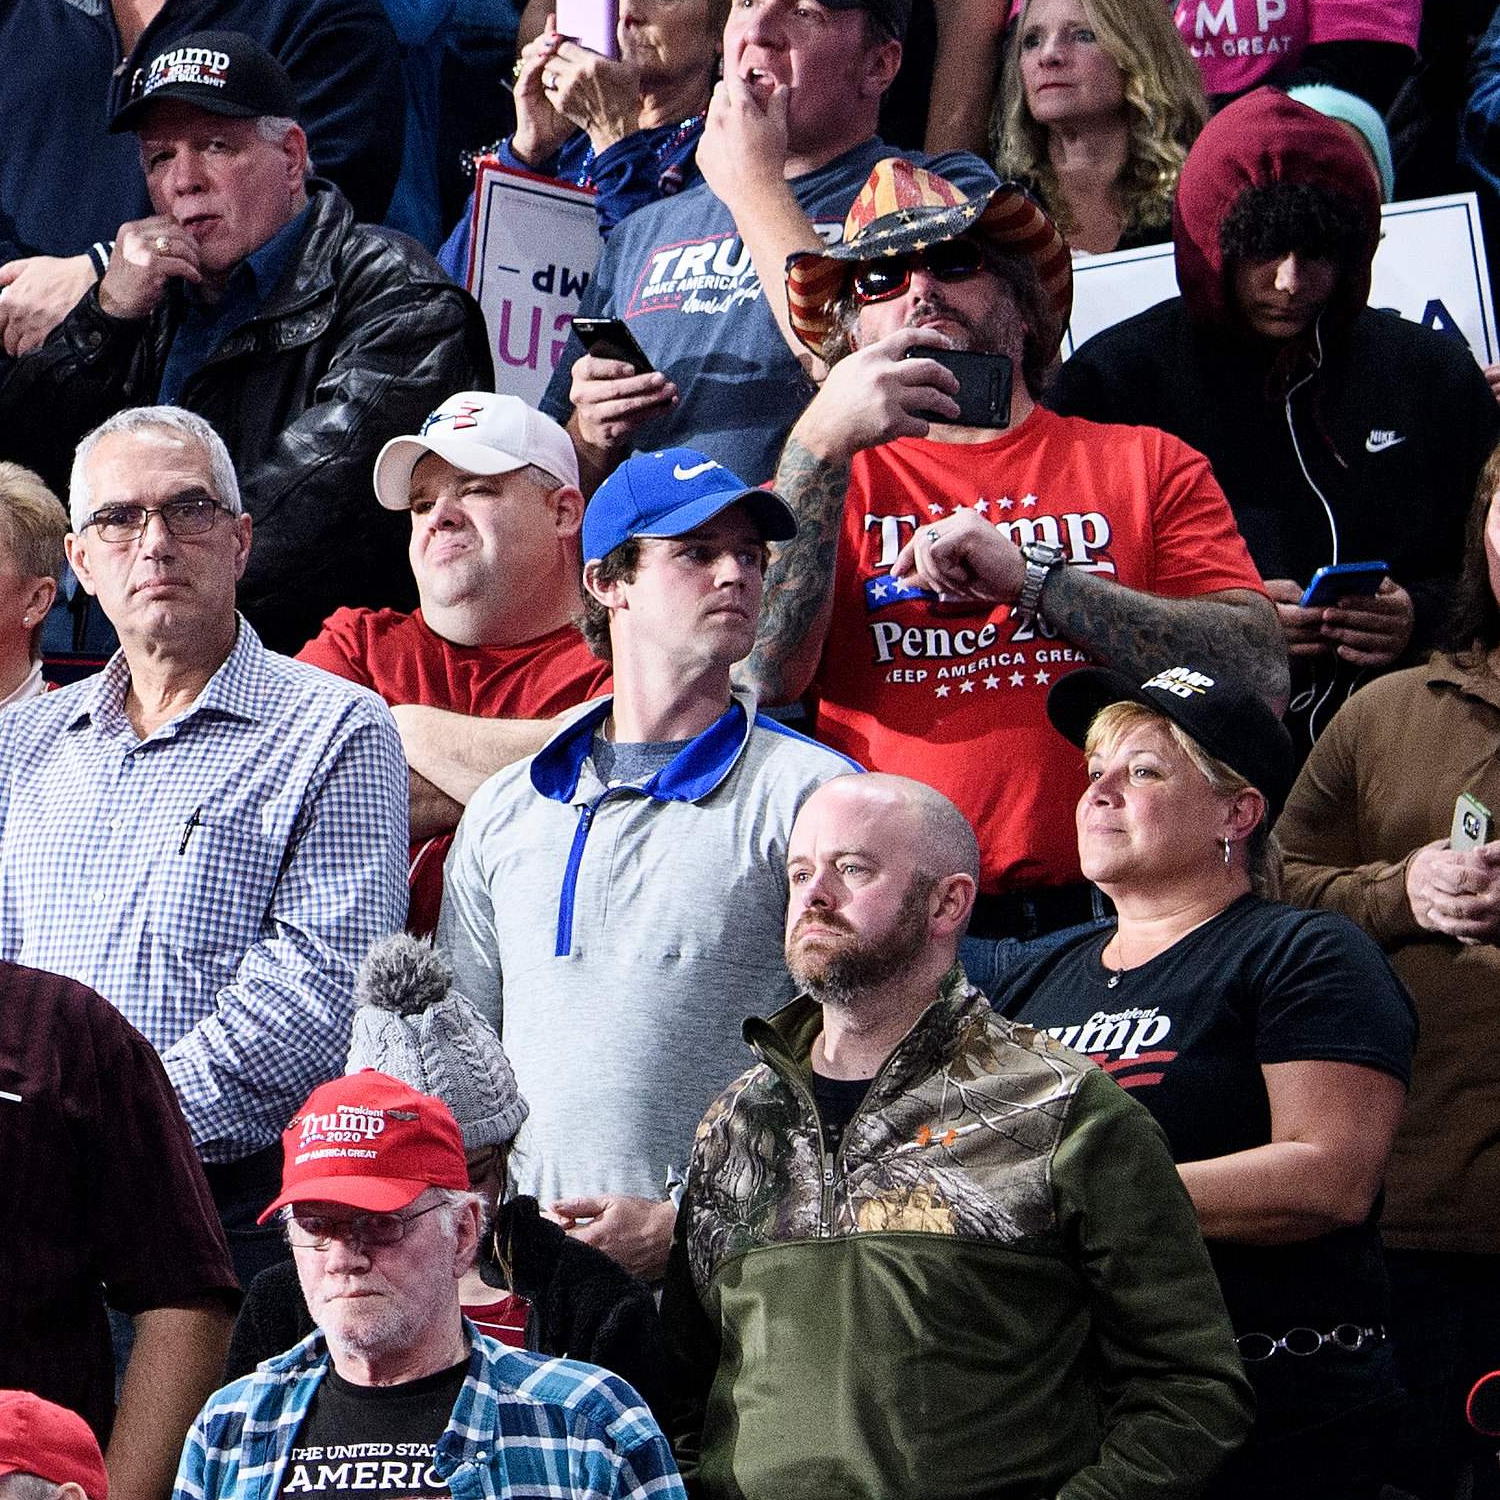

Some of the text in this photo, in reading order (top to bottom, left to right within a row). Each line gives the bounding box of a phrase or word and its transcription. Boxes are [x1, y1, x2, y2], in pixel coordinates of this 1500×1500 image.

[1223, 35, 1292, 58] GREAT
[149, 47, 230, 78] Trump
[183, 73, 227, 89] BULLSHIT
[650, 238, 756, 284] TRU
[642, 279, 675, 297] MAKE
[676, 274, 738, 293] AMERICA
[1369, 429, 1397, 444] NIKE
[864, 510, 1112, 569] Tmp
[870, 619, 1002, 663] Pence
[937, 652, 1027, 679] AMERICA
[1090, 1006, 1158, 1030] President
[1046, 1013, 1172, 1060] ump
[336, 1104, 384, 1119] President
[300, 1112, 385, 1140] Trump
[326, 1131, 362, 1144] 2020
[311, 1148, 347, 1162] AMERICA
[346, 1147, 379, 1160] GREAT
[291, 1442, 446, 1464] THE UNITED STA
[284, 1463, 455, 1494] AMERI
